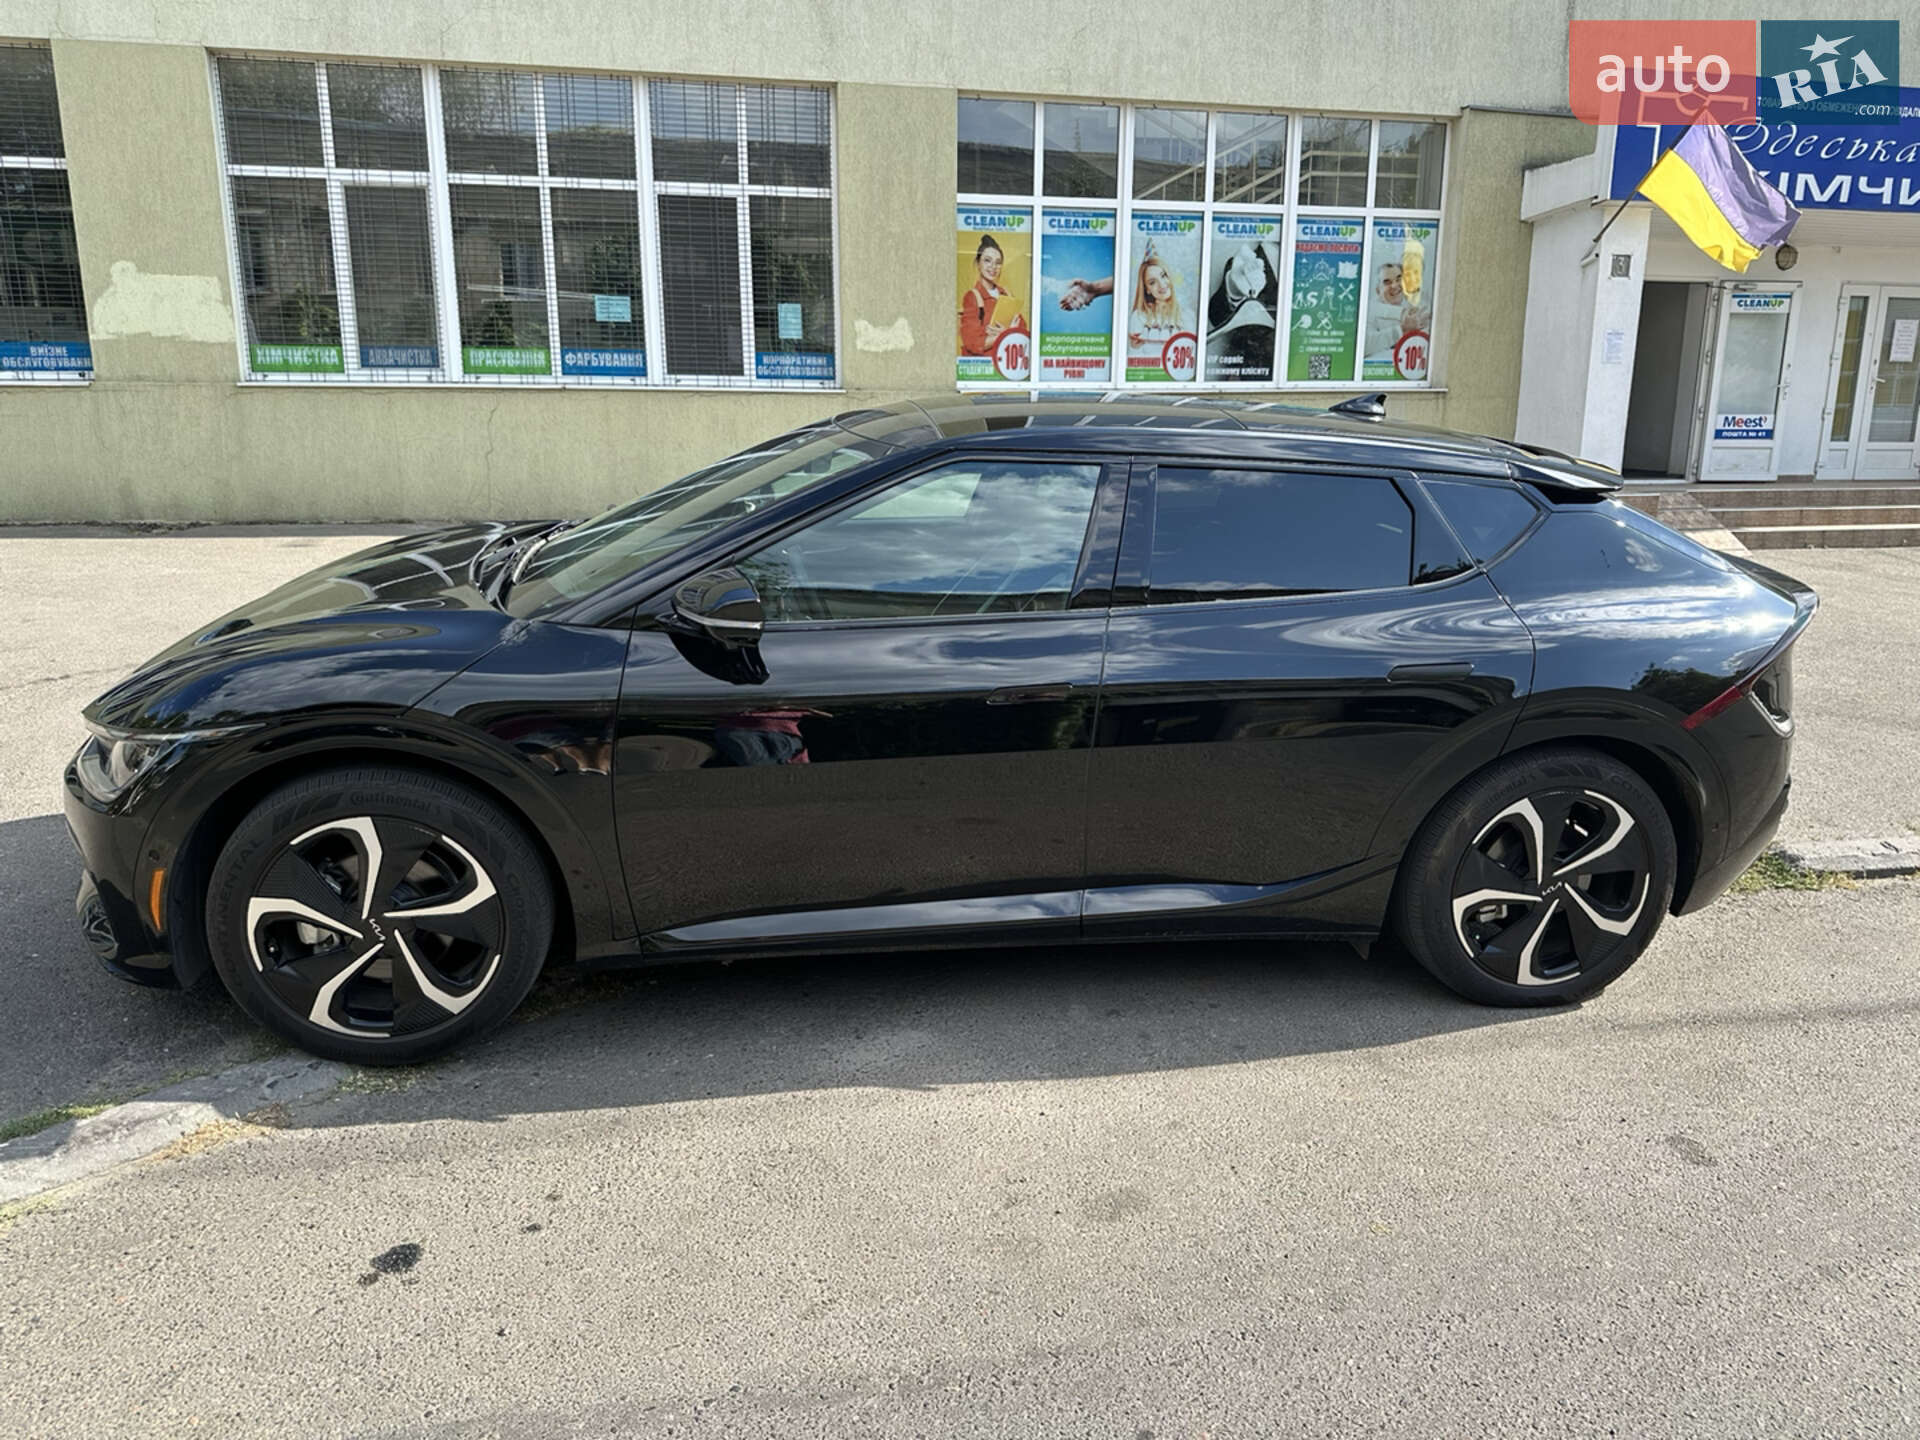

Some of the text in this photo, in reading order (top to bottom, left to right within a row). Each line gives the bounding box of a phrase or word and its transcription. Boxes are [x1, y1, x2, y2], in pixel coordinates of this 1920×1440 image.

[1757, 170, 1920, 206] ІМЧИ
[964, 215, 1025, 227] CLEANUP
[1048, 217, 1108, 229] CLEANUP
[1137, 220, 1196, 232] CLEANUP
[1217, 223, 1274, 235] CLEANUP
[1302, 225, 1356, 237] CLEANUP
[1736, 299, 1785, 308] CLEANUP
[255, 345, 340, 365] ХІМЧИСТКА
[368, 349, 434, 366] АКВАЧИСТКА
[469, 348, 546, 367] ПРАСУВАННЯ
[564, 350, 644, 368] ФАРБУВАННЯ
[2, 356, 94, 370] ОБСЛУГОВУВАНН
